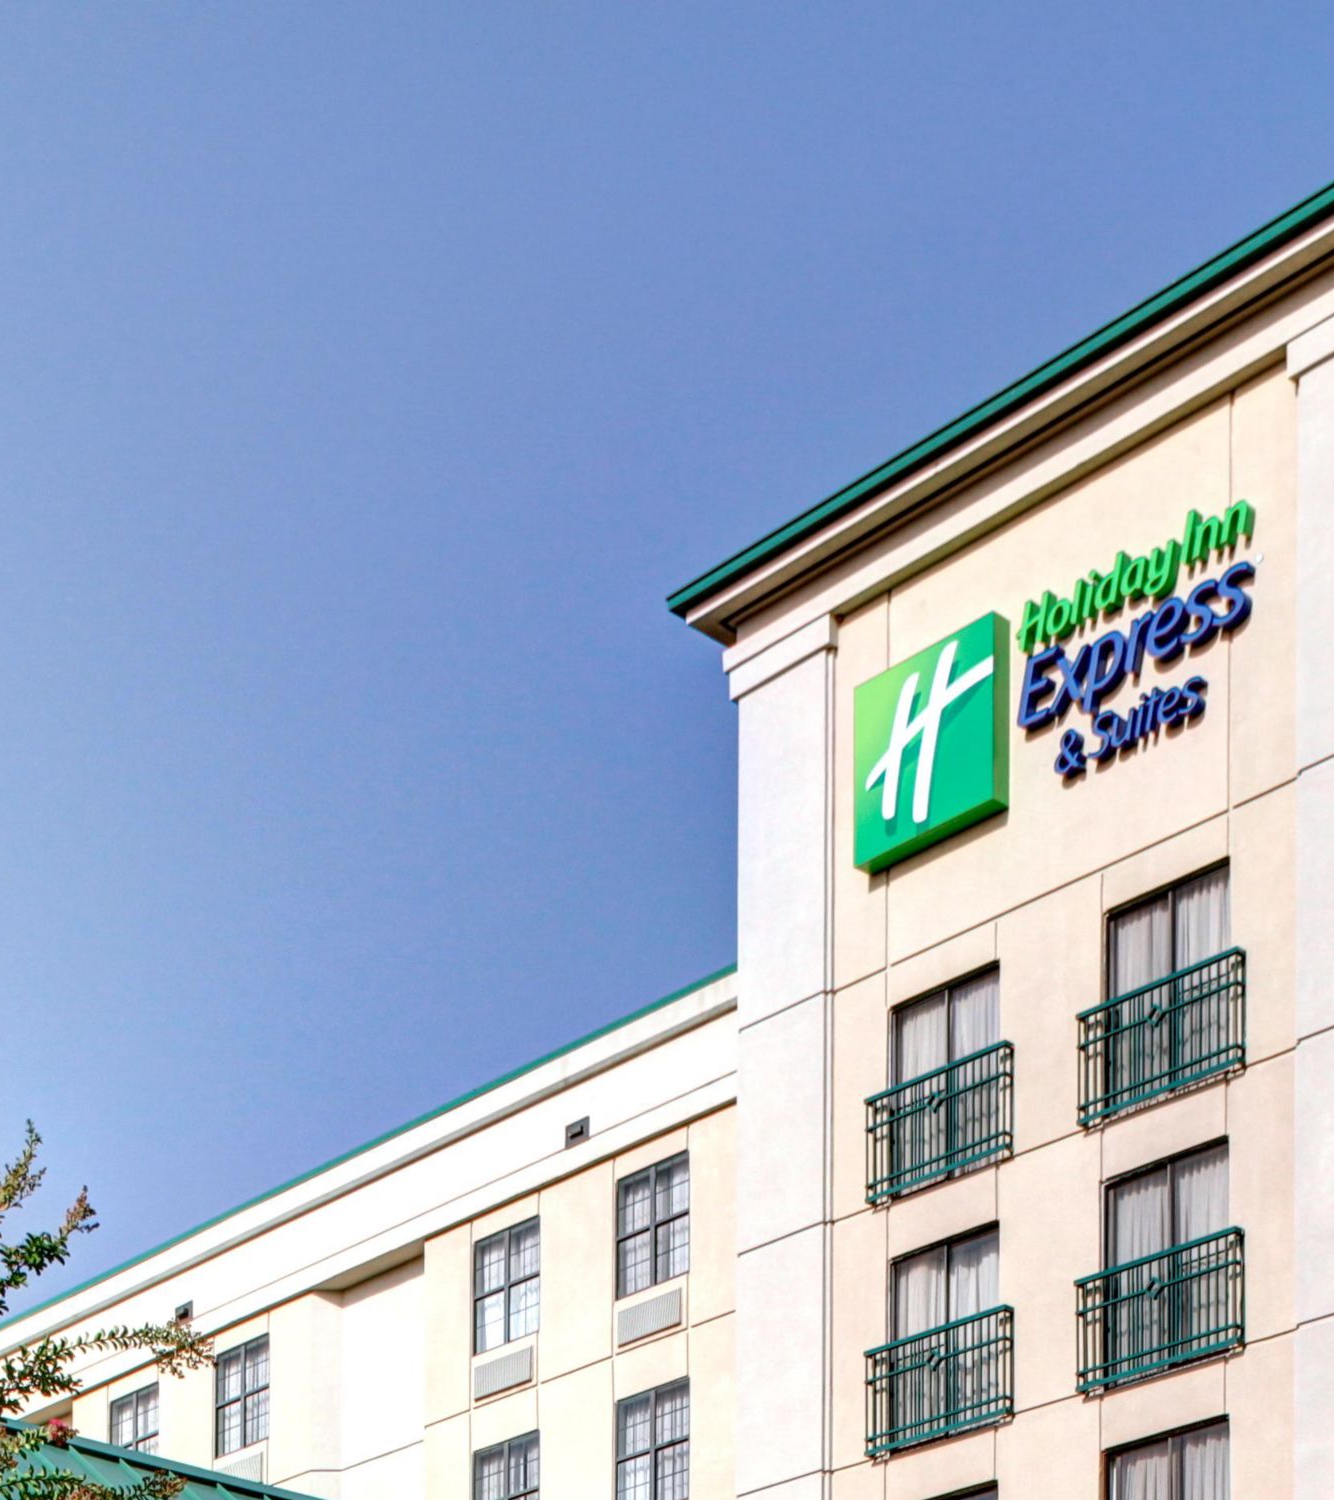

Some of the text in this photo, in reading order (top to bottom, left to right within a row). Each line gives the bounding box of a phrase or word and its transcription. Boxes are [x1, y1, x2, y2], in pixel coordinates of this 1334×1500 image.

[1016, 499, 1256, 653] Holiday Inn
[1017, 561, 1256, 729] Express
[1054, 676, 1209, 776] & Suites
